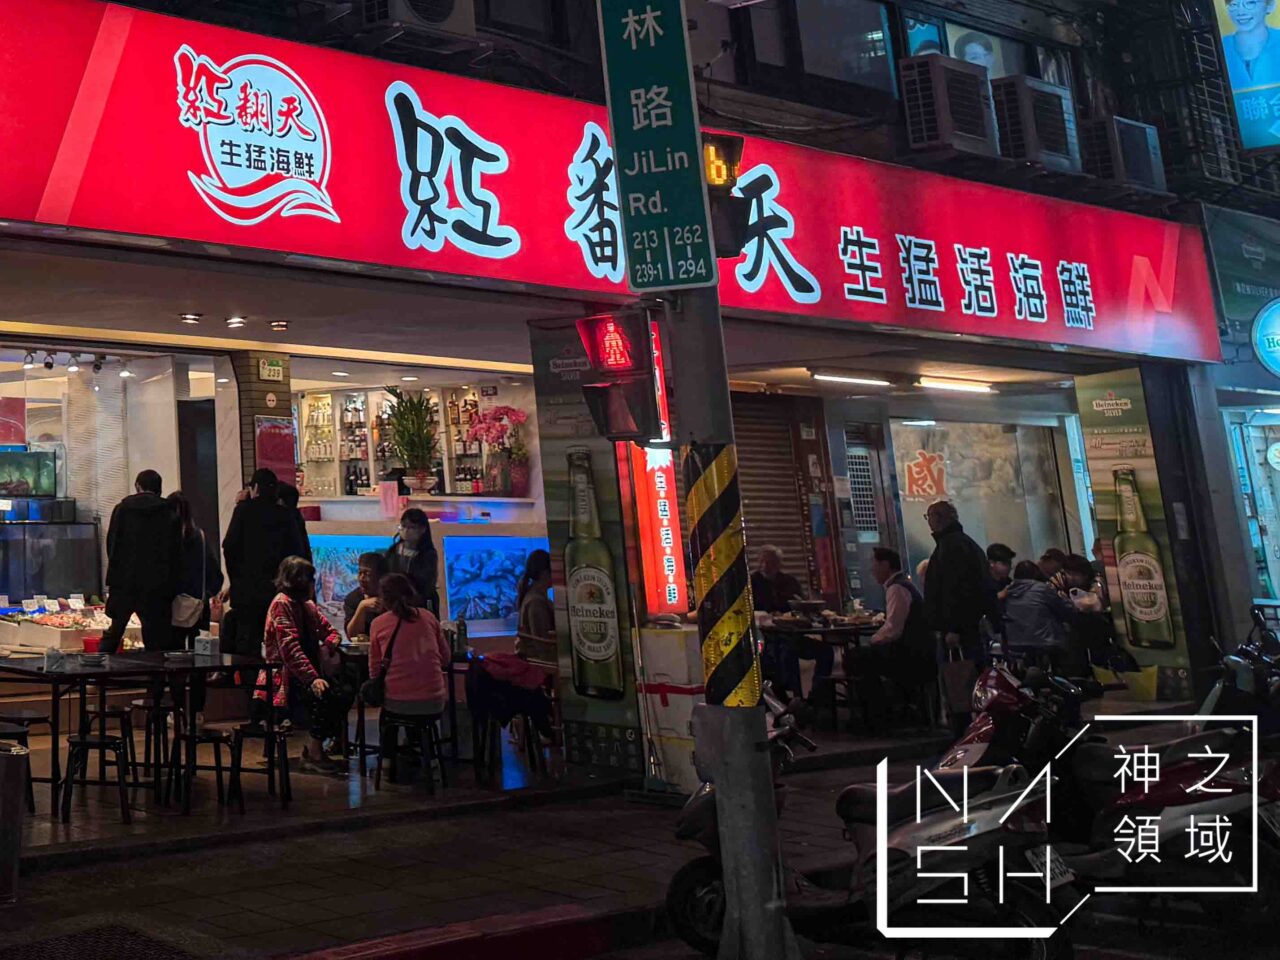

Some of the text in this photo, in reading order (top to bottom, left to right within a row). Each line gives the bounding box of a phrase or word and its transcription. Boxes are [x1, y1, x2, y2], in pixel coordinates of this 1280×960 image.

[219, 138, 316, 180] 生猛海鮮
[624, 145, 689, 178] JiLin
[628, 190, 669, 219] Rd.
[632, 230, 661, 249] 213
[674, 224, 703, 246] 262
[677, 257, 707, 280] 294
[836, 226, 1096, 332] 生猛活海鮮
[1094, 400, 1130, 409] Heineken
[1123, 581, 1164, 591] Heineken
[570, 606, 616, 620] Heineken
